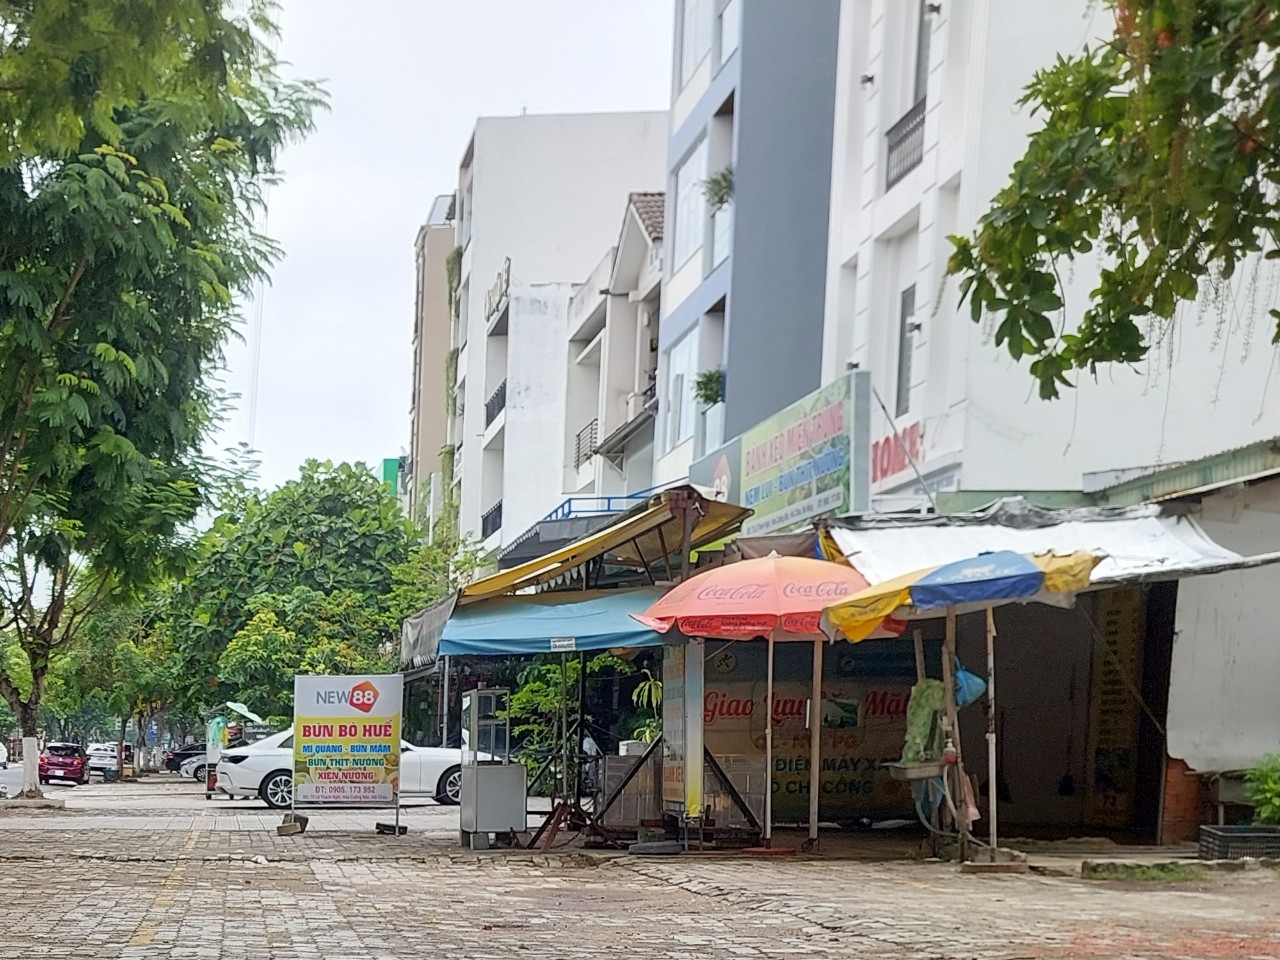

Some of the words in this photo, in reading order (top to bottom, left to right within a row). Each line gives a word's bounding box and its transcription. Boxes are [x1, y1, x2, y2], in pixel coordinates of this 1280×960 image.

[704, 691, 755, 723] Giao
[302, 722, 334, 738] BÚN
[338, 721, 358, 738] BÒ
[362, 720, 393, 737] HUẾ
[308, 757, 327, 767] BÚN
[330, 758, 350, 768] THỊT
[317, 770, 339, 780] XIÊN
[315, 786, 327, 794] ĐT:
[349, 786, 361, 794] 173
[363, 786, 376, 794] 952
